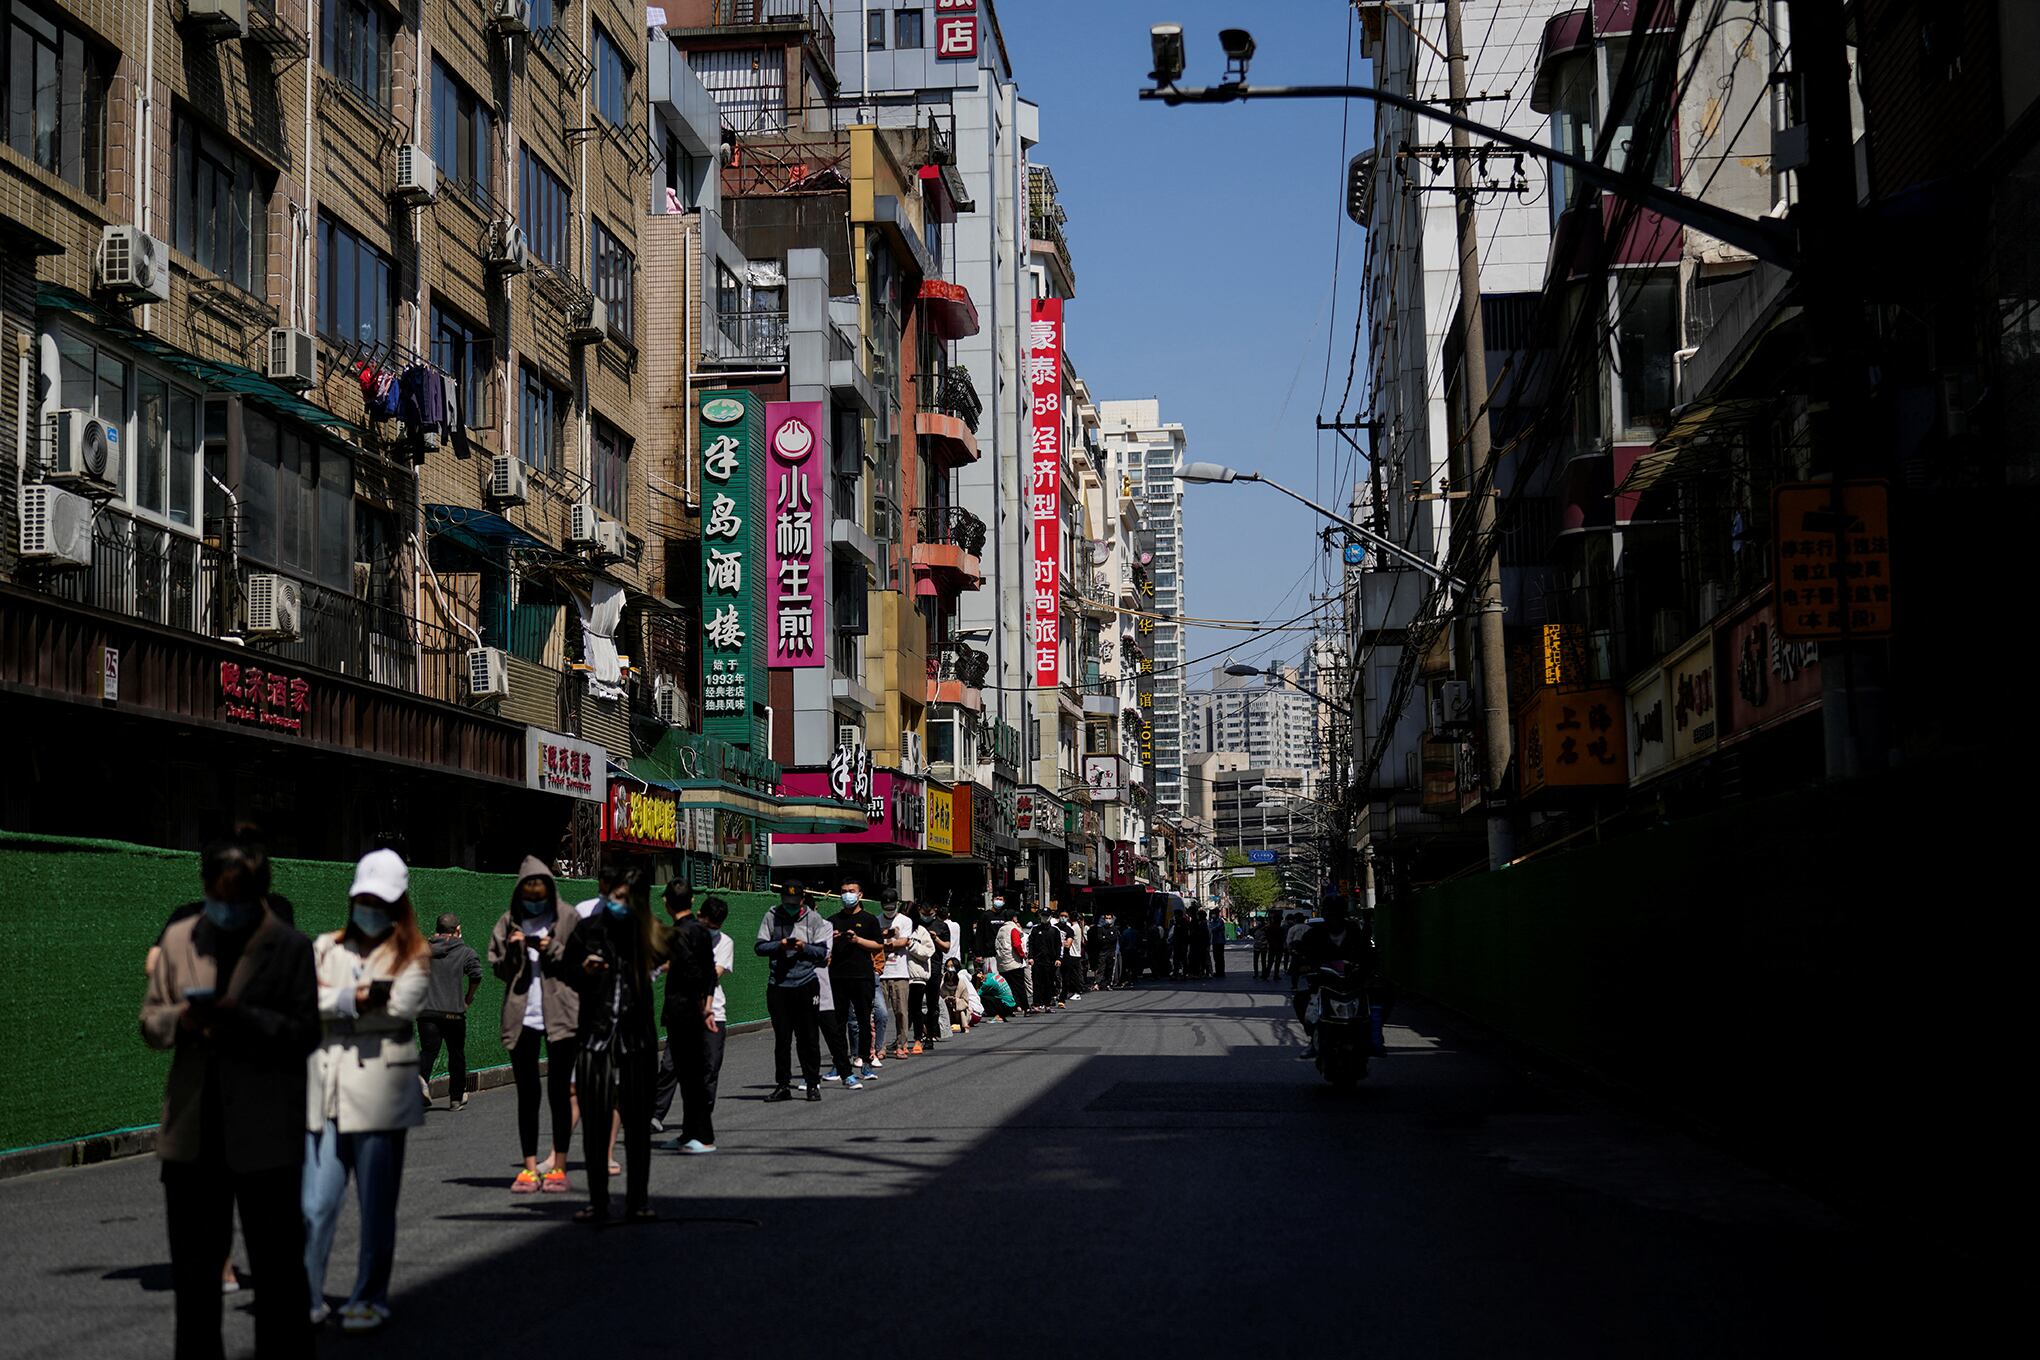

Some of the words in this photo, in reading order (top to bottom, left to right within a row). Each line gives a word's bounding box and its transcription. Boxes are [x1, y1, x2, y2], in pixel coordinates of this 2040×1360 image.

[939, 0, 973, 54] 店
[704, 435, 746, 650] 半岛酒楼
[777, 465, 814, 651] 小杨生煎
[713, 658, 738, 671] 始于
[705, 674, 745, 686] 1993年
[705, 686, 745, 699] 经典老店
[704, 698, 745, 711] 独具风味
[831, 744, 868, 797] 半岛
[867, 797, 884, 818] 煎
